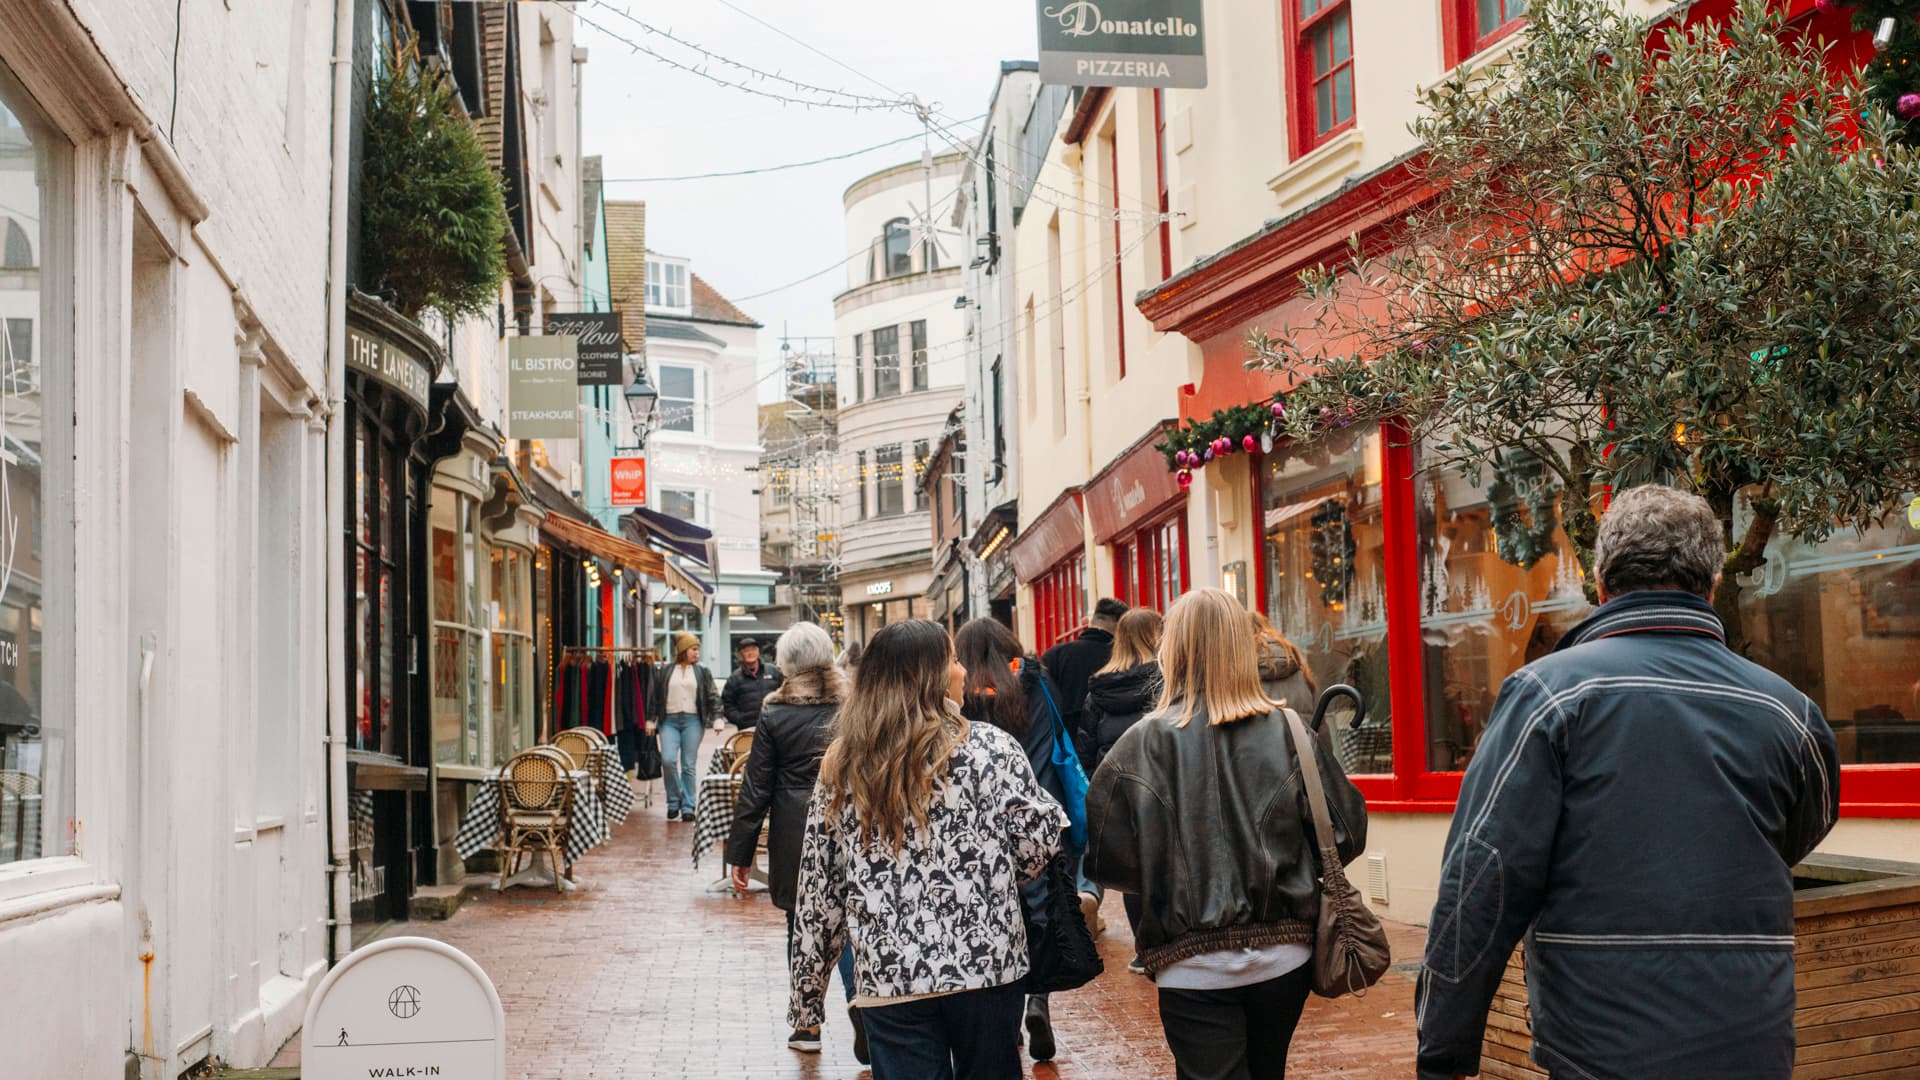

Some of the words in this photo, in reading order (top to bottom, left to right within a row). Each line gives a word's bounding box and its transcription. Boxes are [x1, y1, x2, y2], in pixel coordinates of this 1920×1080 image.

[1044, 0, 1197, 37] Donatello
[1076, 60, 1170, 78] PIZZERIA
[351, 334, 379, 370] THE
[383, 348, 415, 390] LANES
[580, 352, 619, 360] CLOTHING
[511, 358, 522, 370] IL
[525, 358, 575, 370] BISTRO
[511, 411, 575, 420] STEAKHOUSE
[368, 1066, 440, 1079] WALK-IN
